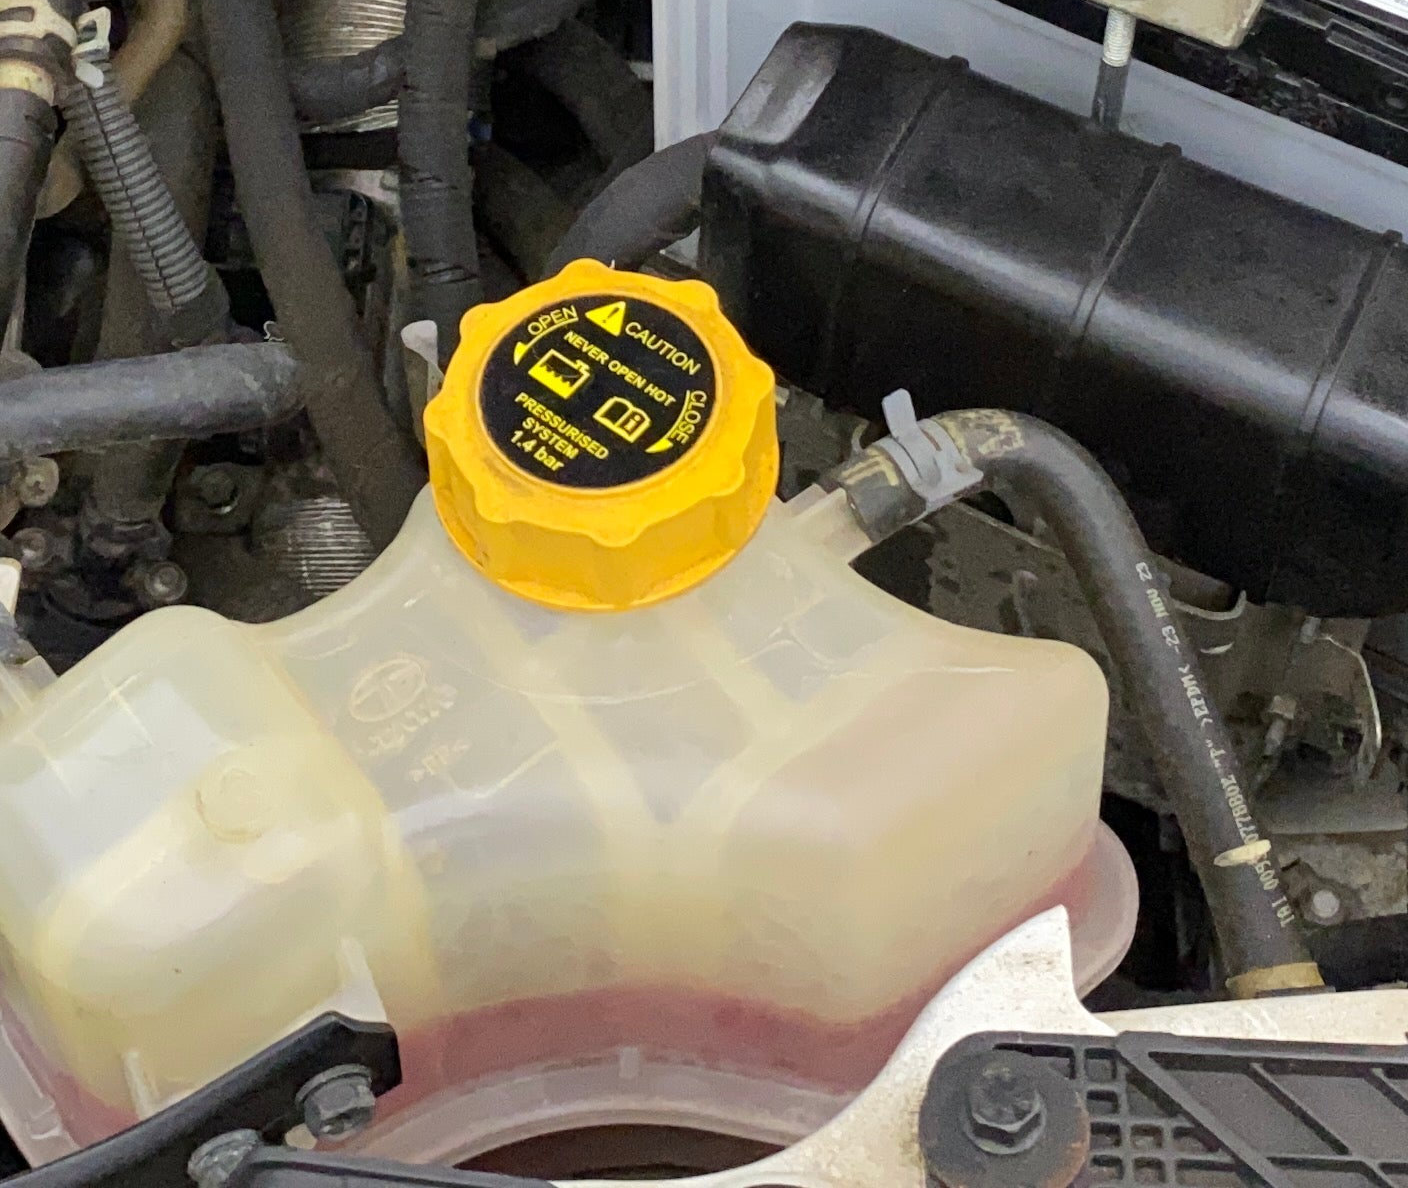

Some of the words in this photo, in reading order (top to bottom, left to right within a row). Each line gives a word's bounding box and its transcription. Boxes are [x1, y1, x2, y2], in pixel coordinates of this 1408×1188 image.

[527, 305, 578, 337] OPEN
[564, 330, 609, 364] NEVER
[608, 359, 650, 393] OPEN
[643, 382, 676, 407] HOT
[625, 321, 702, 376] CAUTION
[515, 392, 609, 460] PRESSURISED
[522, 418, 579, 460] SYSTEM
[670, 389, 707, 444] CLOSE
[510, 431, 534, 455] 1.4
[532, 446, 565, 473] bar
[1134, 559, 1153, 582] 23
